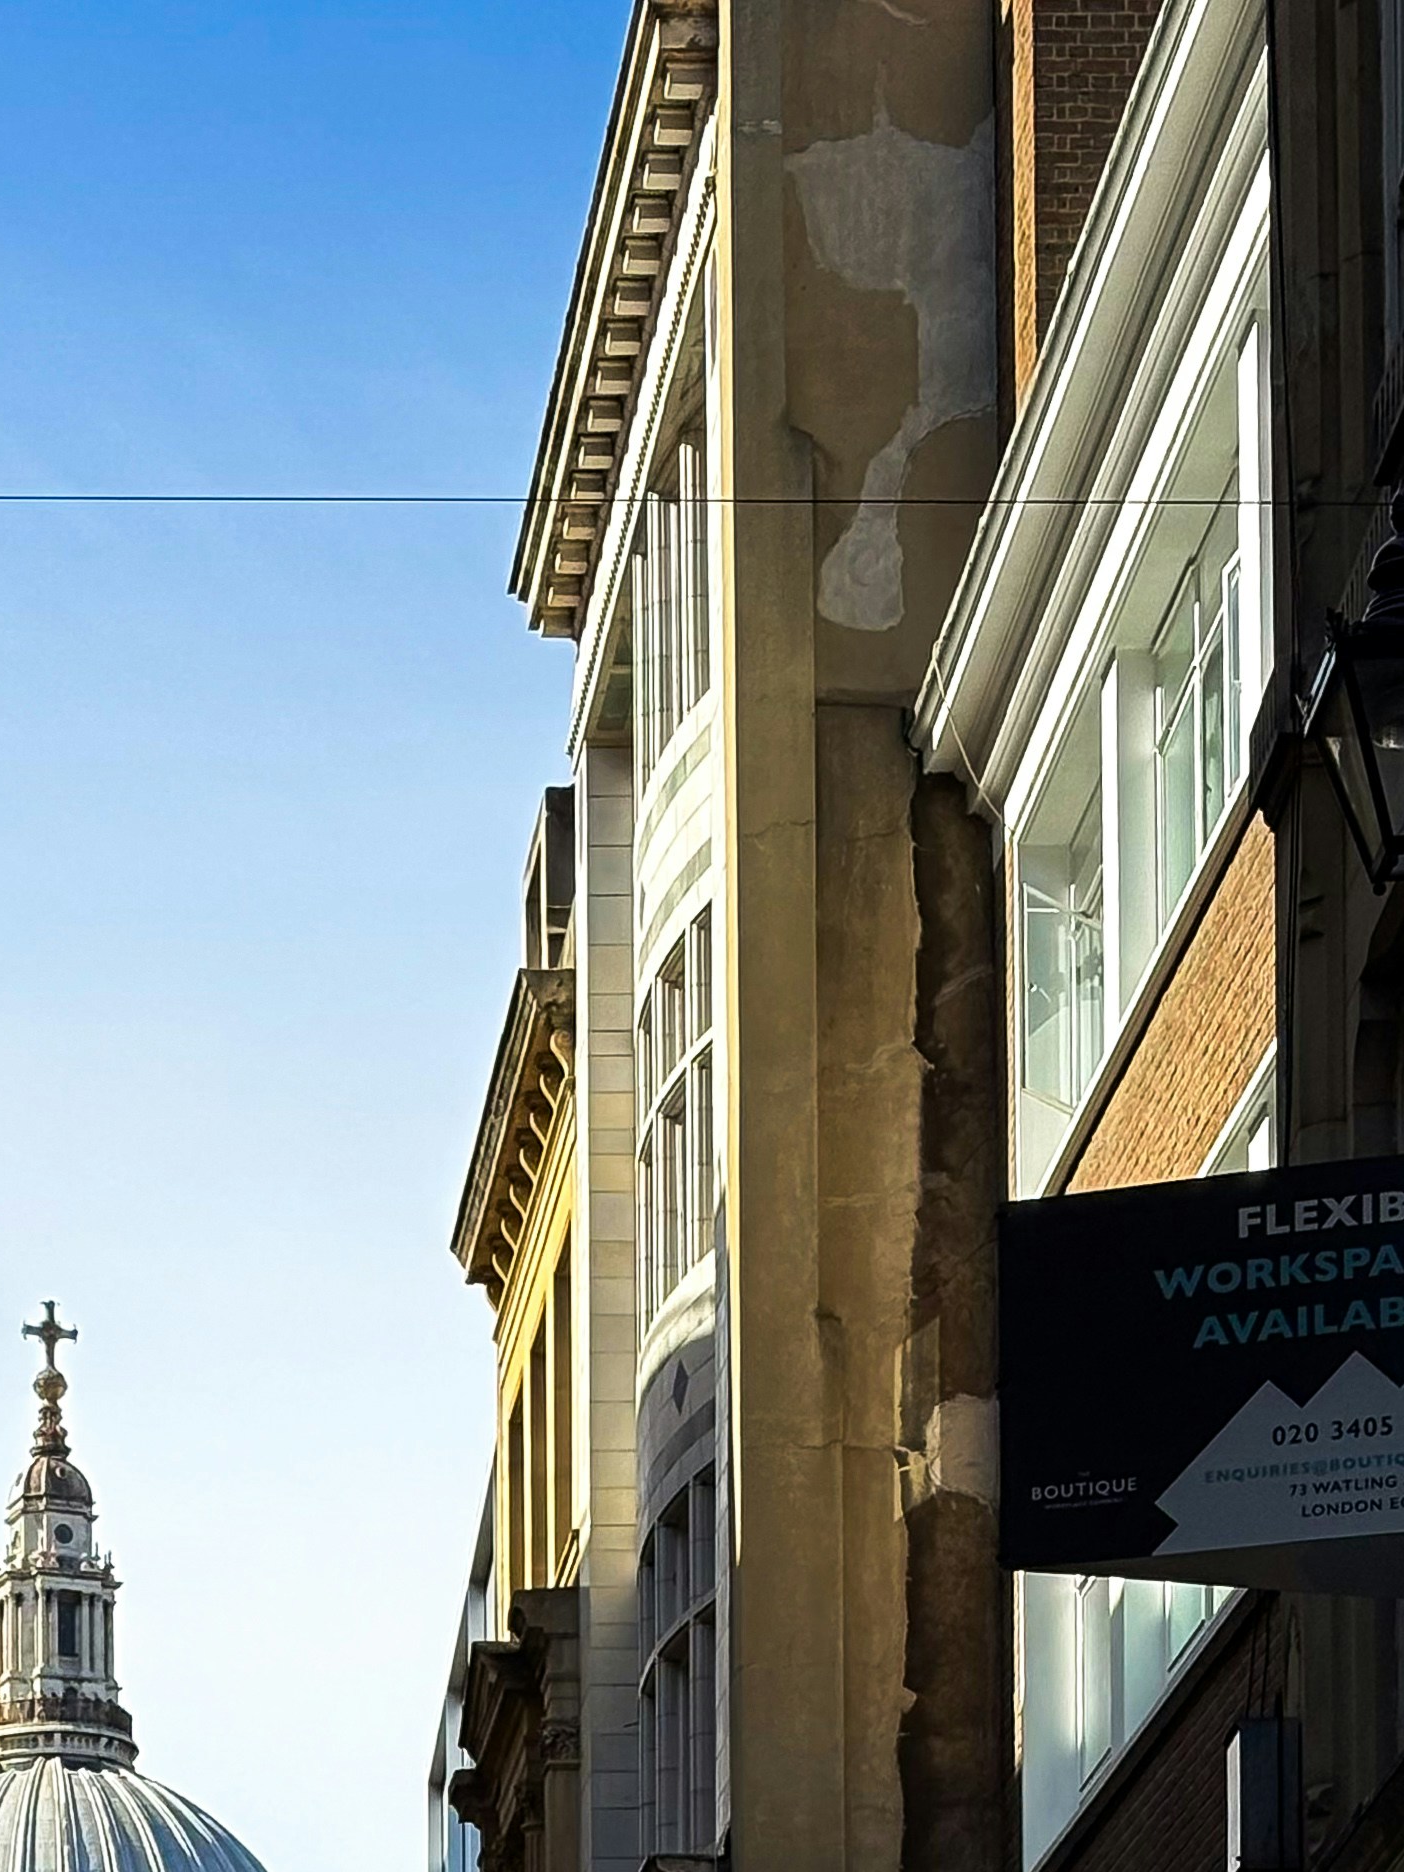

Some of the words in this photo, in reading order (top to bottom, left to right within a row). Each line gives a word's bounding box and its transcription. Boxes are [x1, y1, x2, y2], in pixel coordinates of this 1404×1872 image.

[1237, 1190, 1404, 1240] FLEXIB
[1152, 1244, 1404, 1301] WORKSPA
[1192, 1296, 1404, 1350] AVAILAB
[1272, 1422, 1319, 1446] 020
[1331, 1415, 1393, 1440] 3405
[1031, 1476, 1138, 1502] BOUTIQUE
[1290, 1484, 1308, 1498] 73
[1313, 1475, 1397, 1495] WATLING
[1302, 1499, 1382, 1518] LONDON
[1390, 1496, 1404, 1511] E
